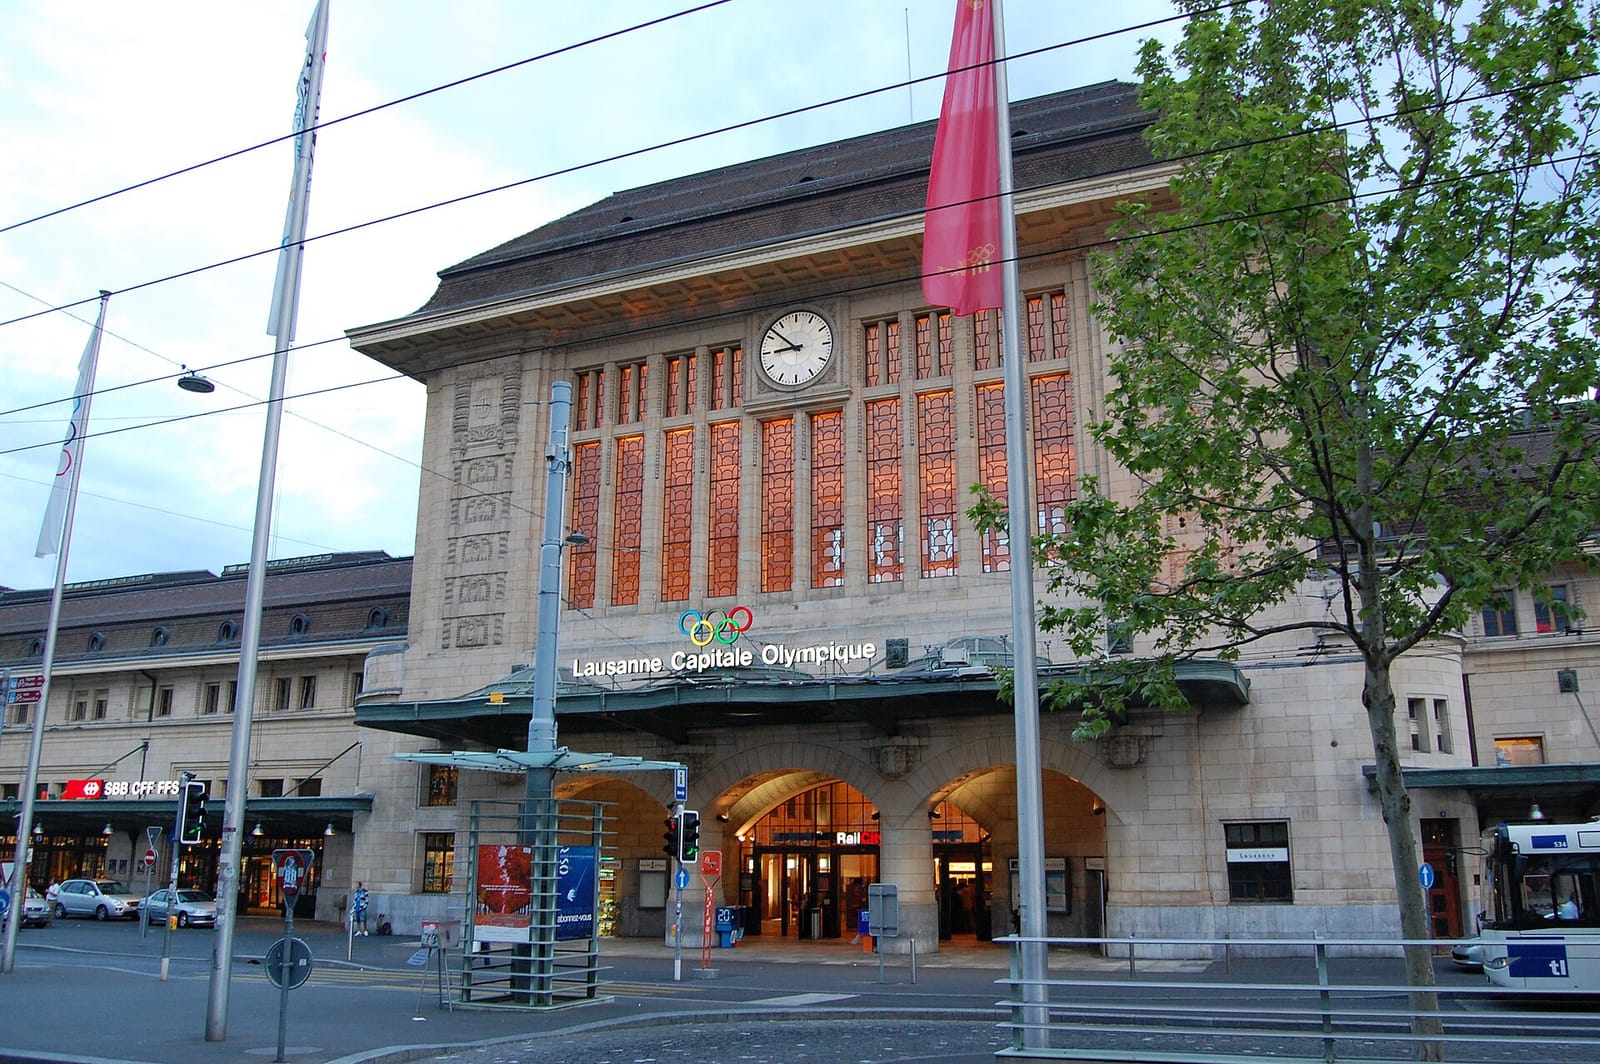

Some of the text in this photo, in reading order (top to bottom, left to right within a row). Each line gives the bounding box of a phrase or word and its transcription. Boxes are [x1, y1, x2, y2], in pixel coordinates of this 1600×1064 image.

[573, 641, 876, 677] Lausanne Capitale Olympique
[104, 780, 180, 795] SBB CFF FFS
[557, 913, 592, 924] abonnez-vous
[717, 908, 730, 922] 20
[1549, 959, 1567, 976] tl
